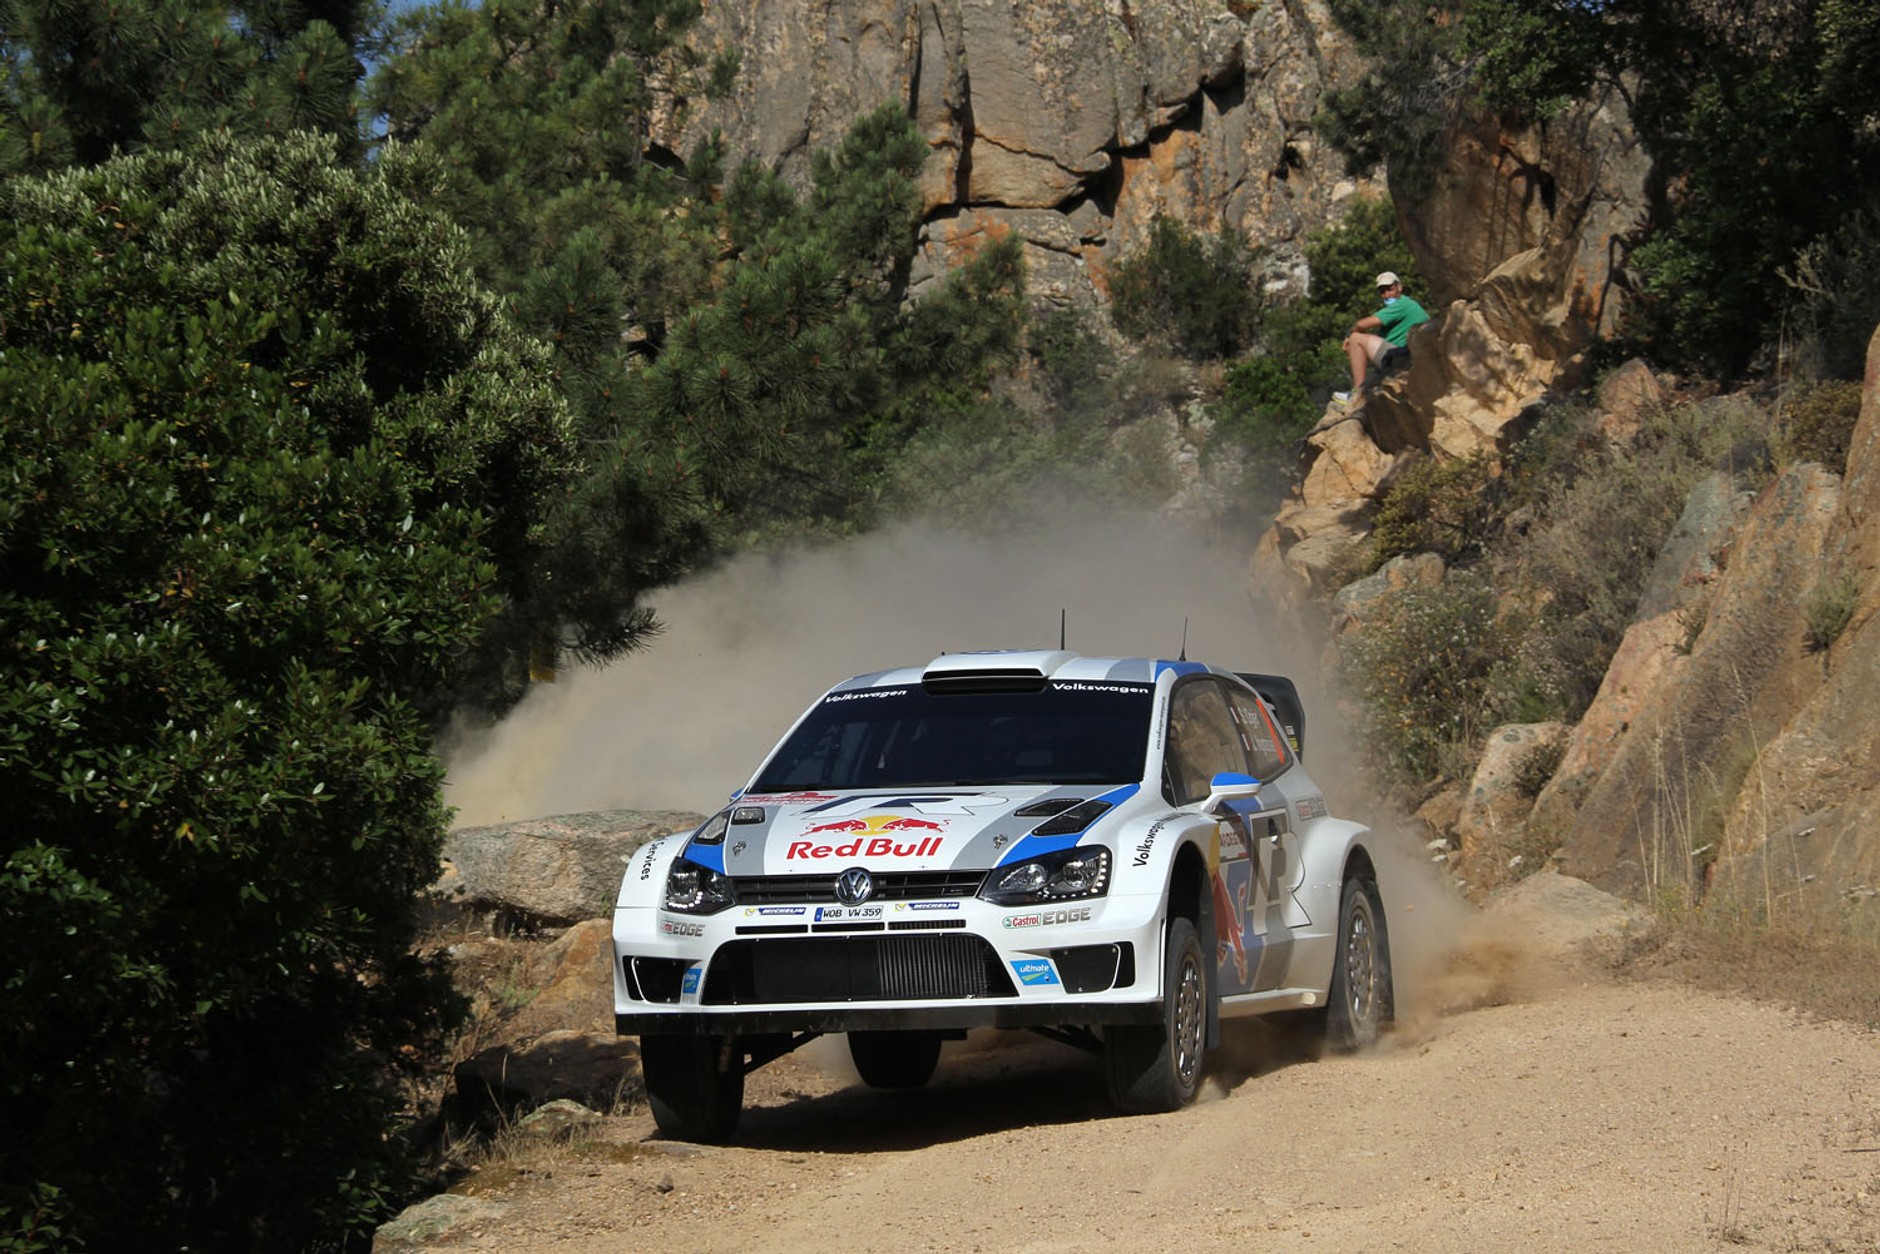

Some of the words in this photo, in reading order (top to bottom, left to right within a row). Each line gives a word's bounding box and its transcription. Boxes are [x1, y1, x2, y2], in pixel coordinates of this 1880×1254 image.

[1052, 682, 1150, 693] Volkswagen
[825, 690, 908, 703] Volkswagen
[786, 838, 863, 860] Red
[865, 836, 944, 857] Bull
[823, 909, 842, 918] WOB
[848, 908, 861, 917] VW
[862, 908, 881, 917] 359
[1012, 916, 1039, 927] Castrol
[1042, 907, 1091, 926] EDGE
[673, 922, 706, 937] EDGE
[1020, 964, 1049, 973] ultimate
